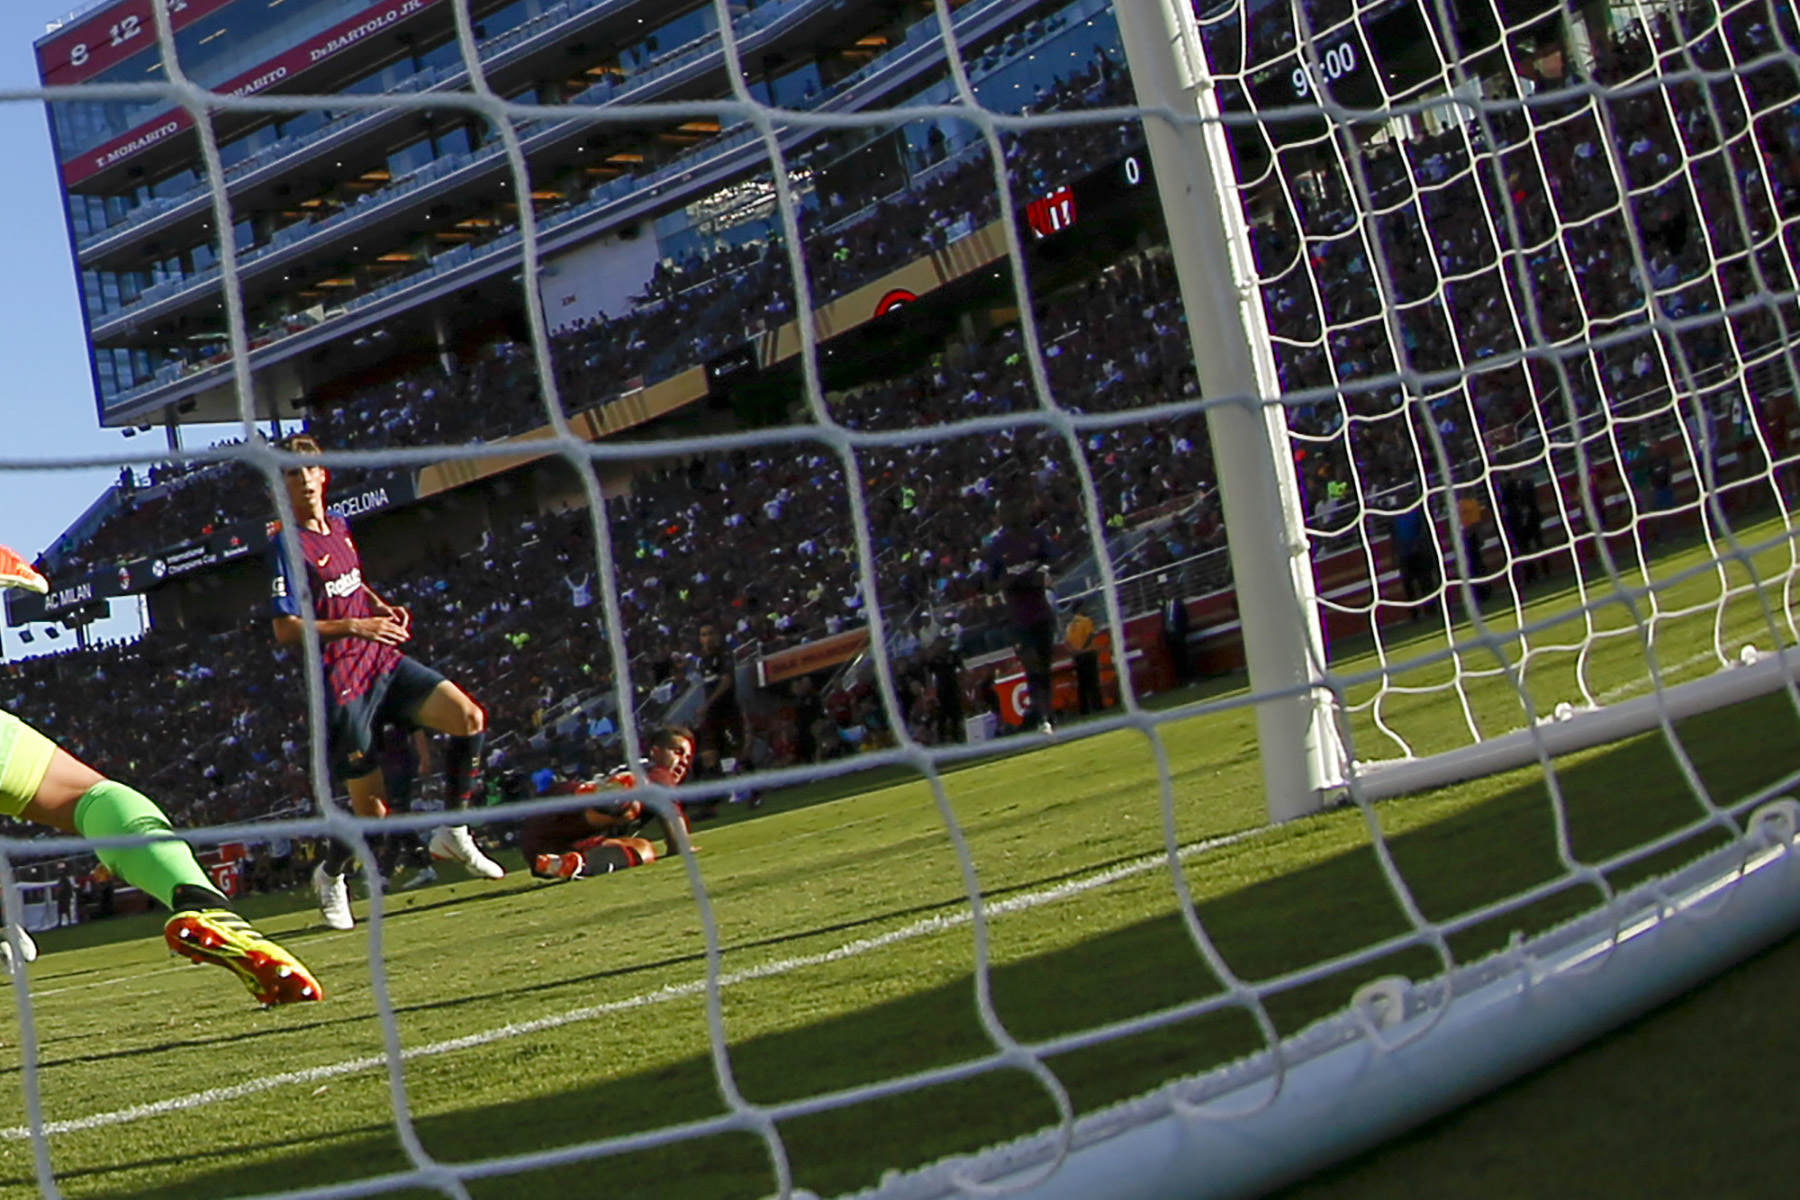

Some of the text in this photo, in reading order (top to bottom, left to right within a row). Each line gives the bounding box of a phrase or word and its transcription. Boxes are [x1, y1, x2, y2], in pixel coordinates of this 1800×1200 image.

[70, 43, 89, 66] 8
[109, 15, 141, 47] 12
[1292, 42, 1355, 97] 9:00
[1125, 157, 1139, 184] 0
[327, 488, 390, 518] RCELONA
[44, 583, 92, 611] AC MILAN
